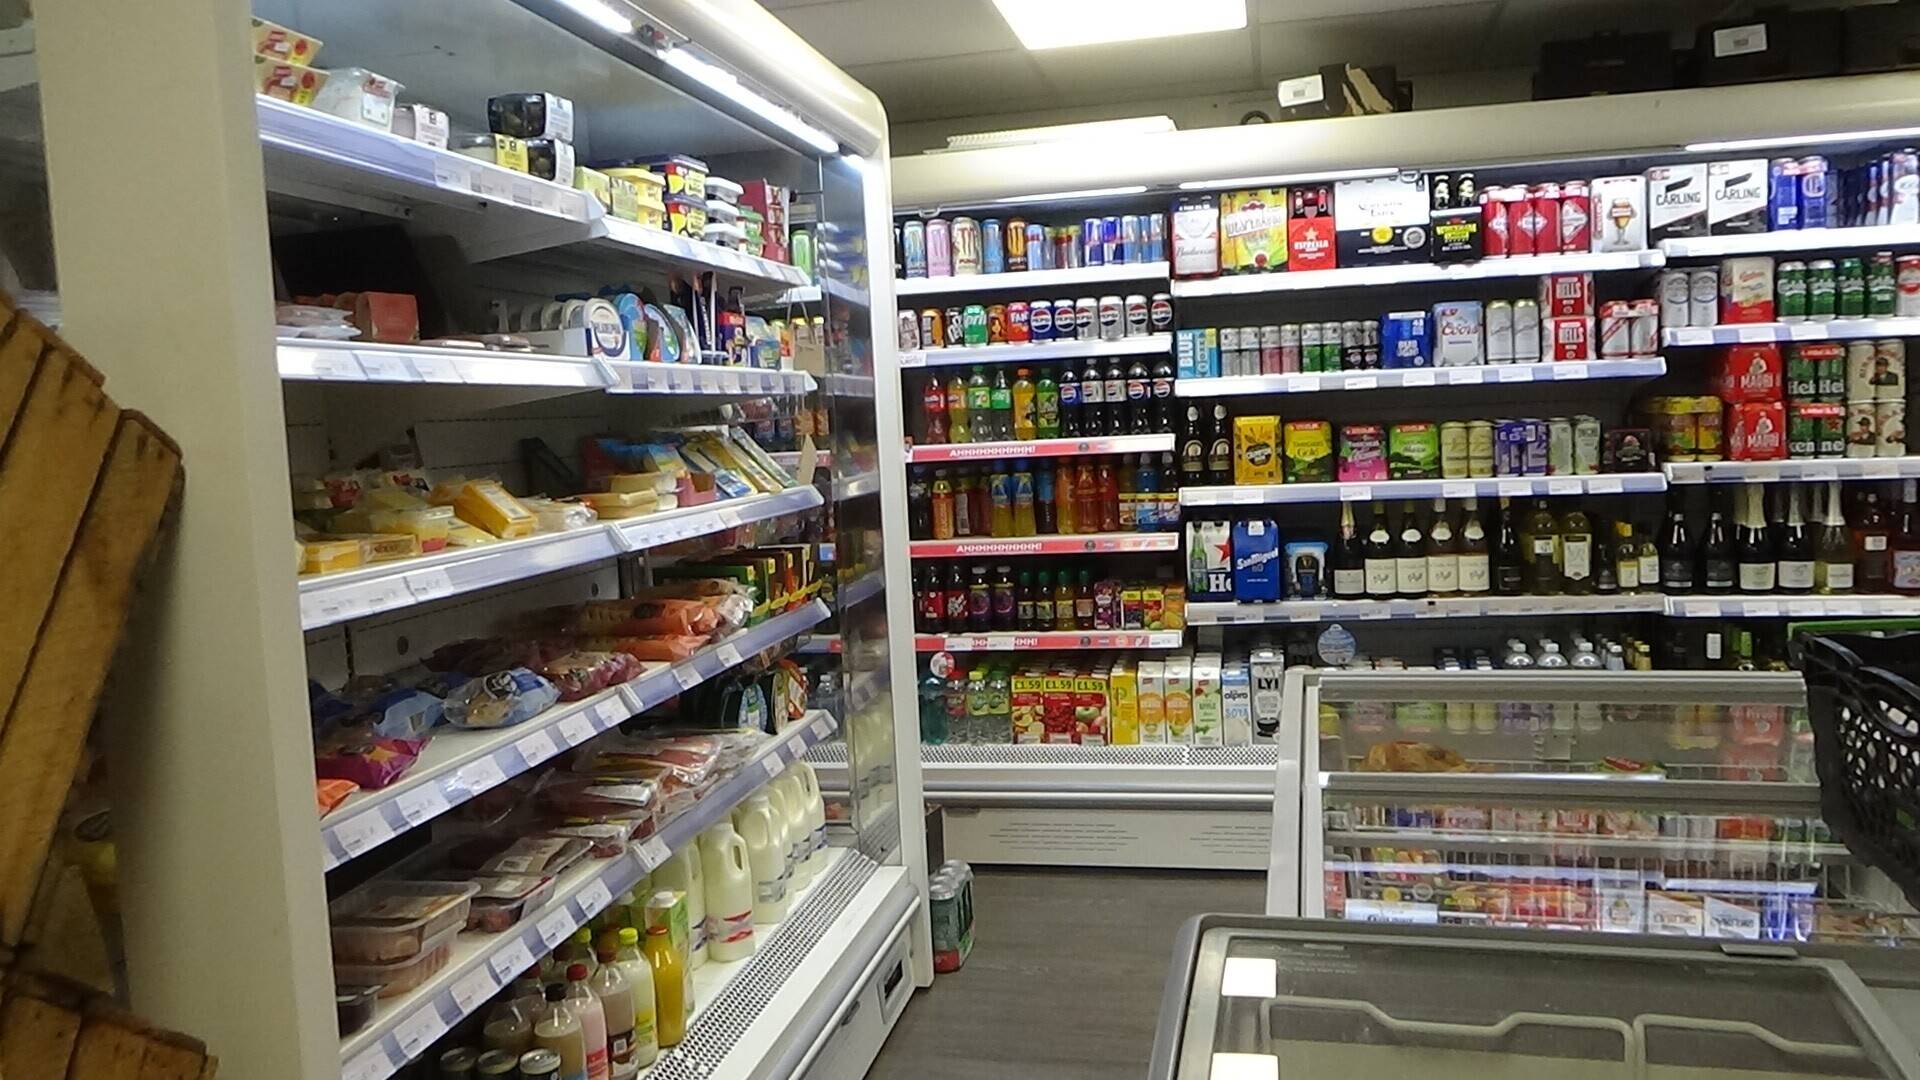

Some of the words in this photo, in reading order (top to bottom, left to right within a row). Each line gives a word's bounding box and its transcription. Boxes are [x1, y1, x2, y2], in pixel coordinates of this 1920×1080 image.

[1656, 192, 1701, 206] CARLING
[1715, 187, 1760, 201] CARLING
[1179, 332, 1194, 368] BLUE
[1014, 680, 1041, 690] £1.59
[1045, 680, 1072, 690] £1.59
[1078, 681, 1104, 691] £1.59
[1224, 690, 1249, 701] alpro
